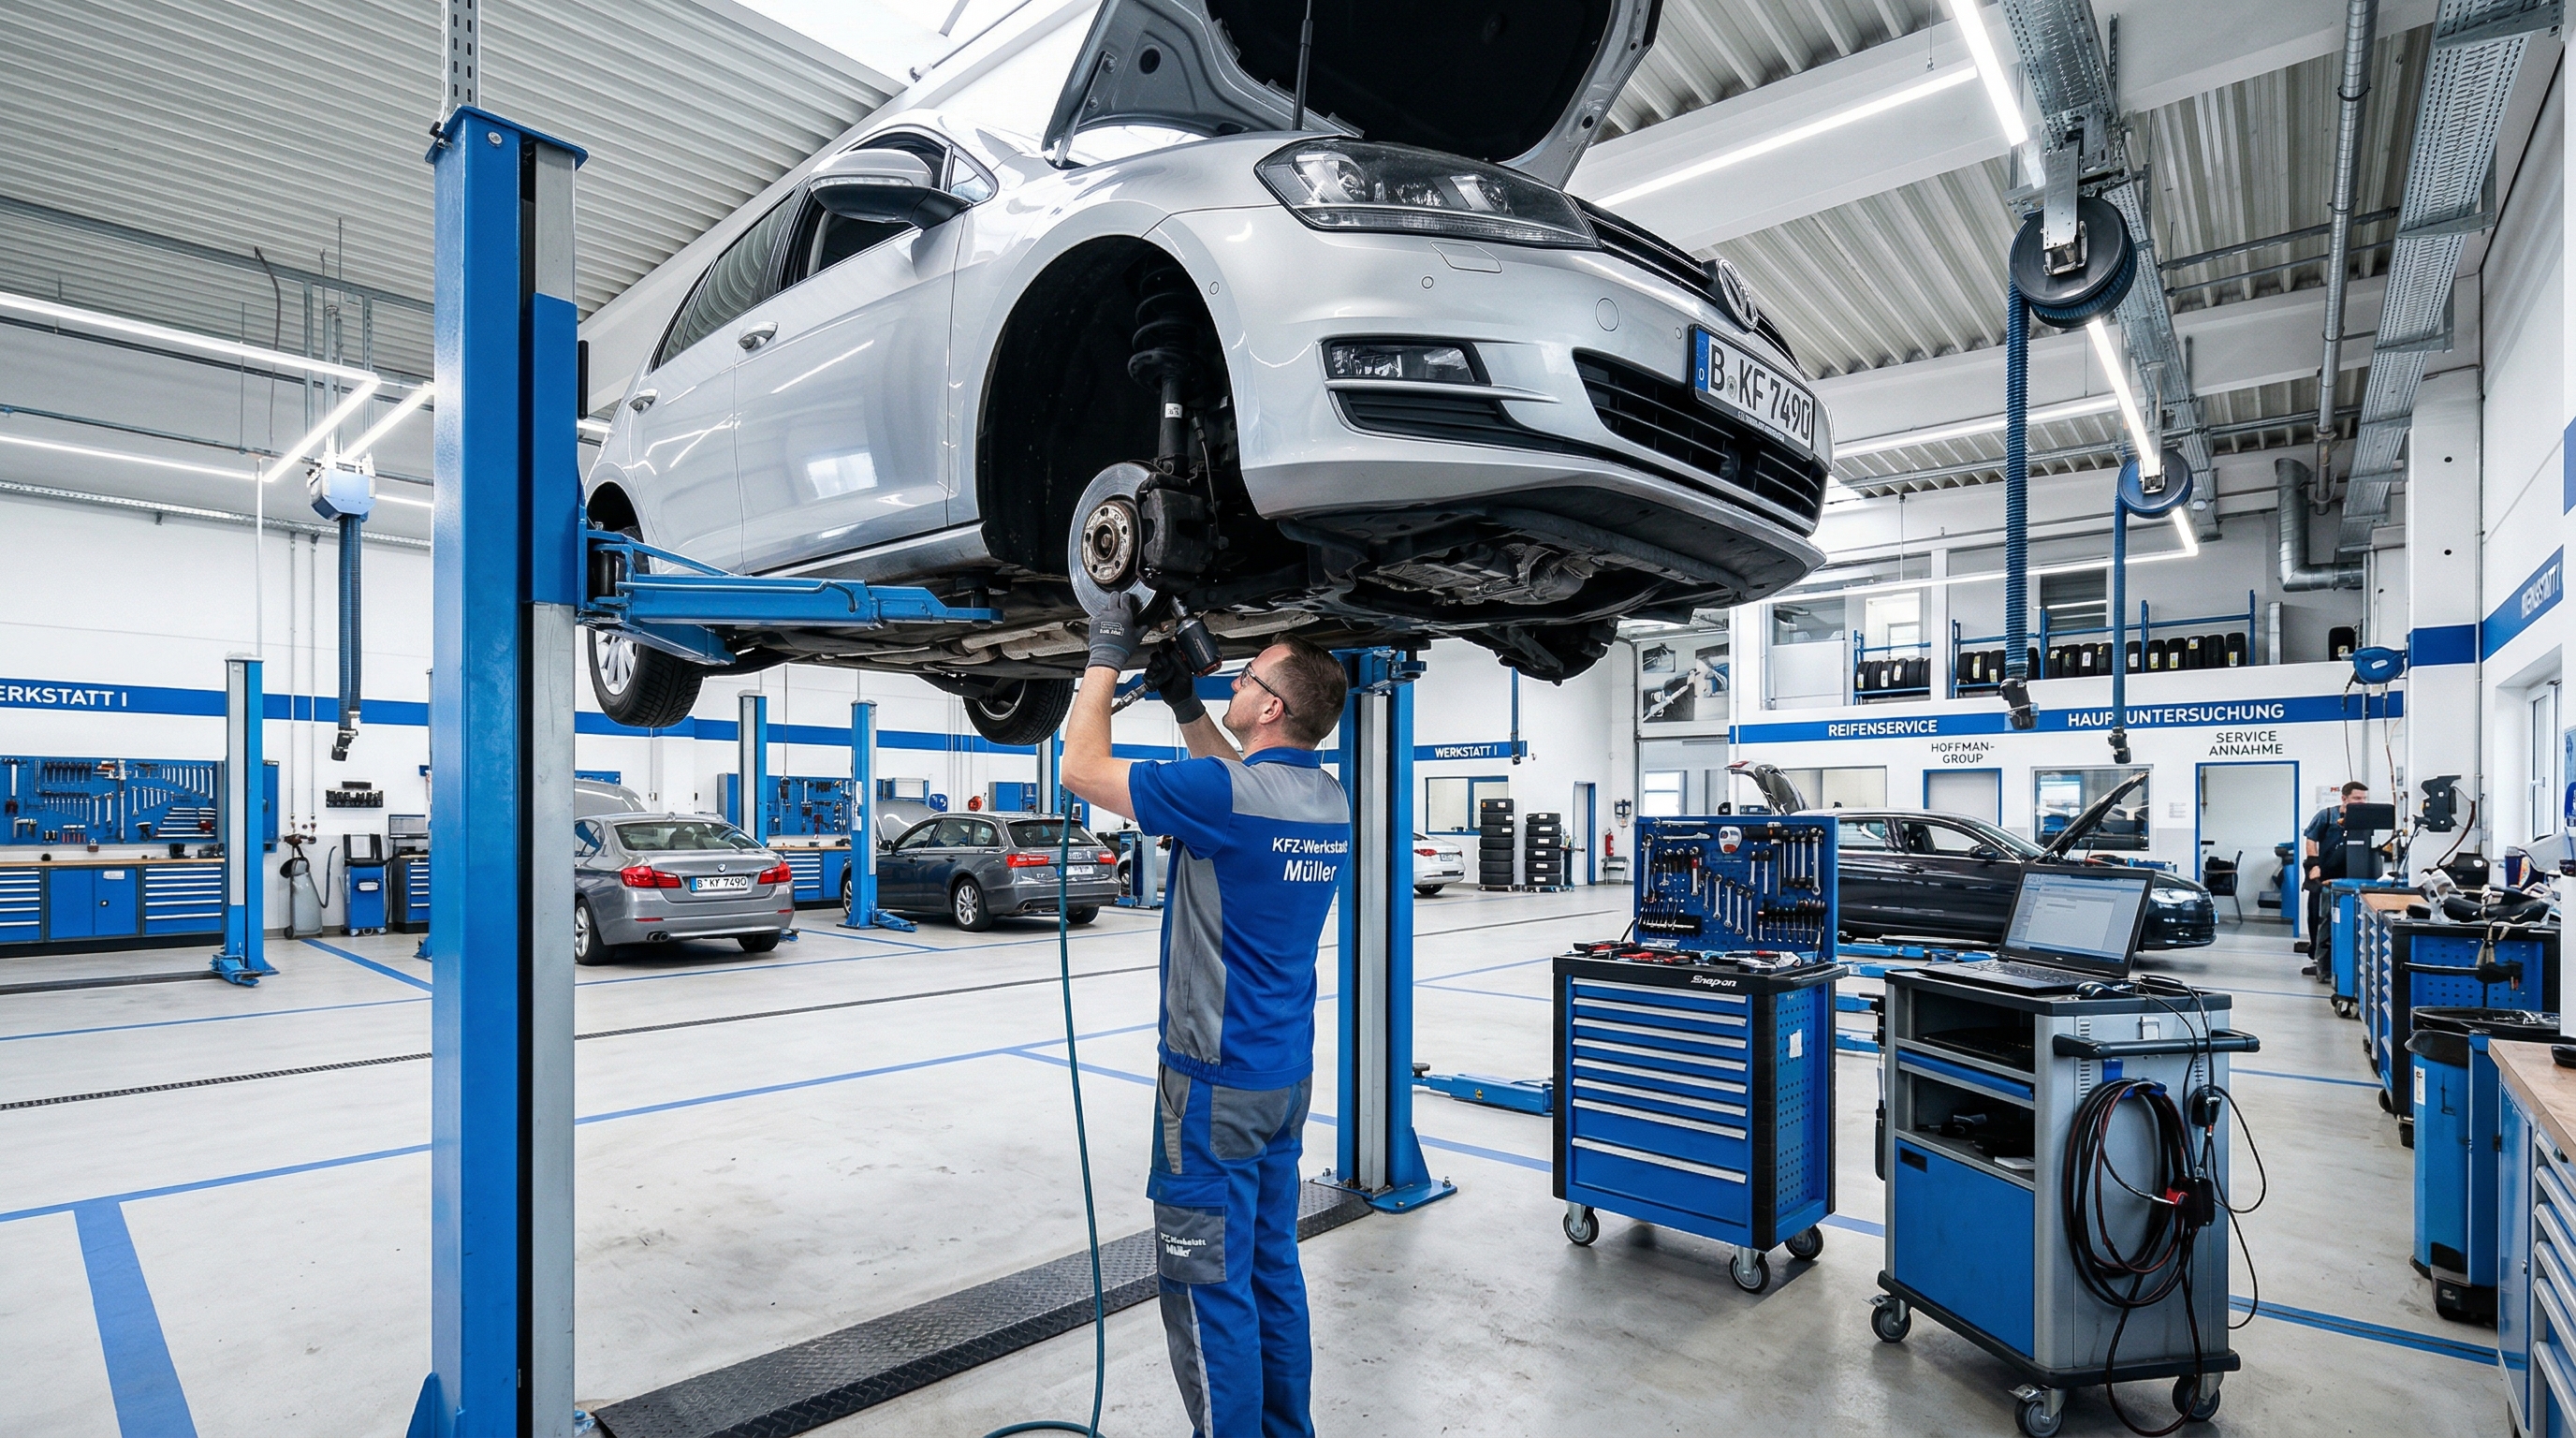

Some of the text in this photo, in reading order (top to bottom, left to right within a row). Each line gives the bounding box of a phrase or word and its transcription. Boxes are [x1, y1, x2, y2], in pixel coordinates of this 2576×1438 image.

[1710, 344, 1725, 391] B
[1738, 359, 1766, 411] KF
[1769, 377, 1811, 441] 7490
[2067, 703, 2285, 727] HAUPUNTERSUCHUNG
[1828, 719, 1938, 737] REIFENSERVICE
[2216, 730, 2277, 743] SERVICE
[1434, 745, 1492, 758] WERKSTATT
[1931, 741, 1996, 753] HOFFMAN-
[2208, 743, 2284, 756] ANNAHME
[1942, 754, 1984, 764] GROUP
[1282, 859, 1338, 882] Müller
